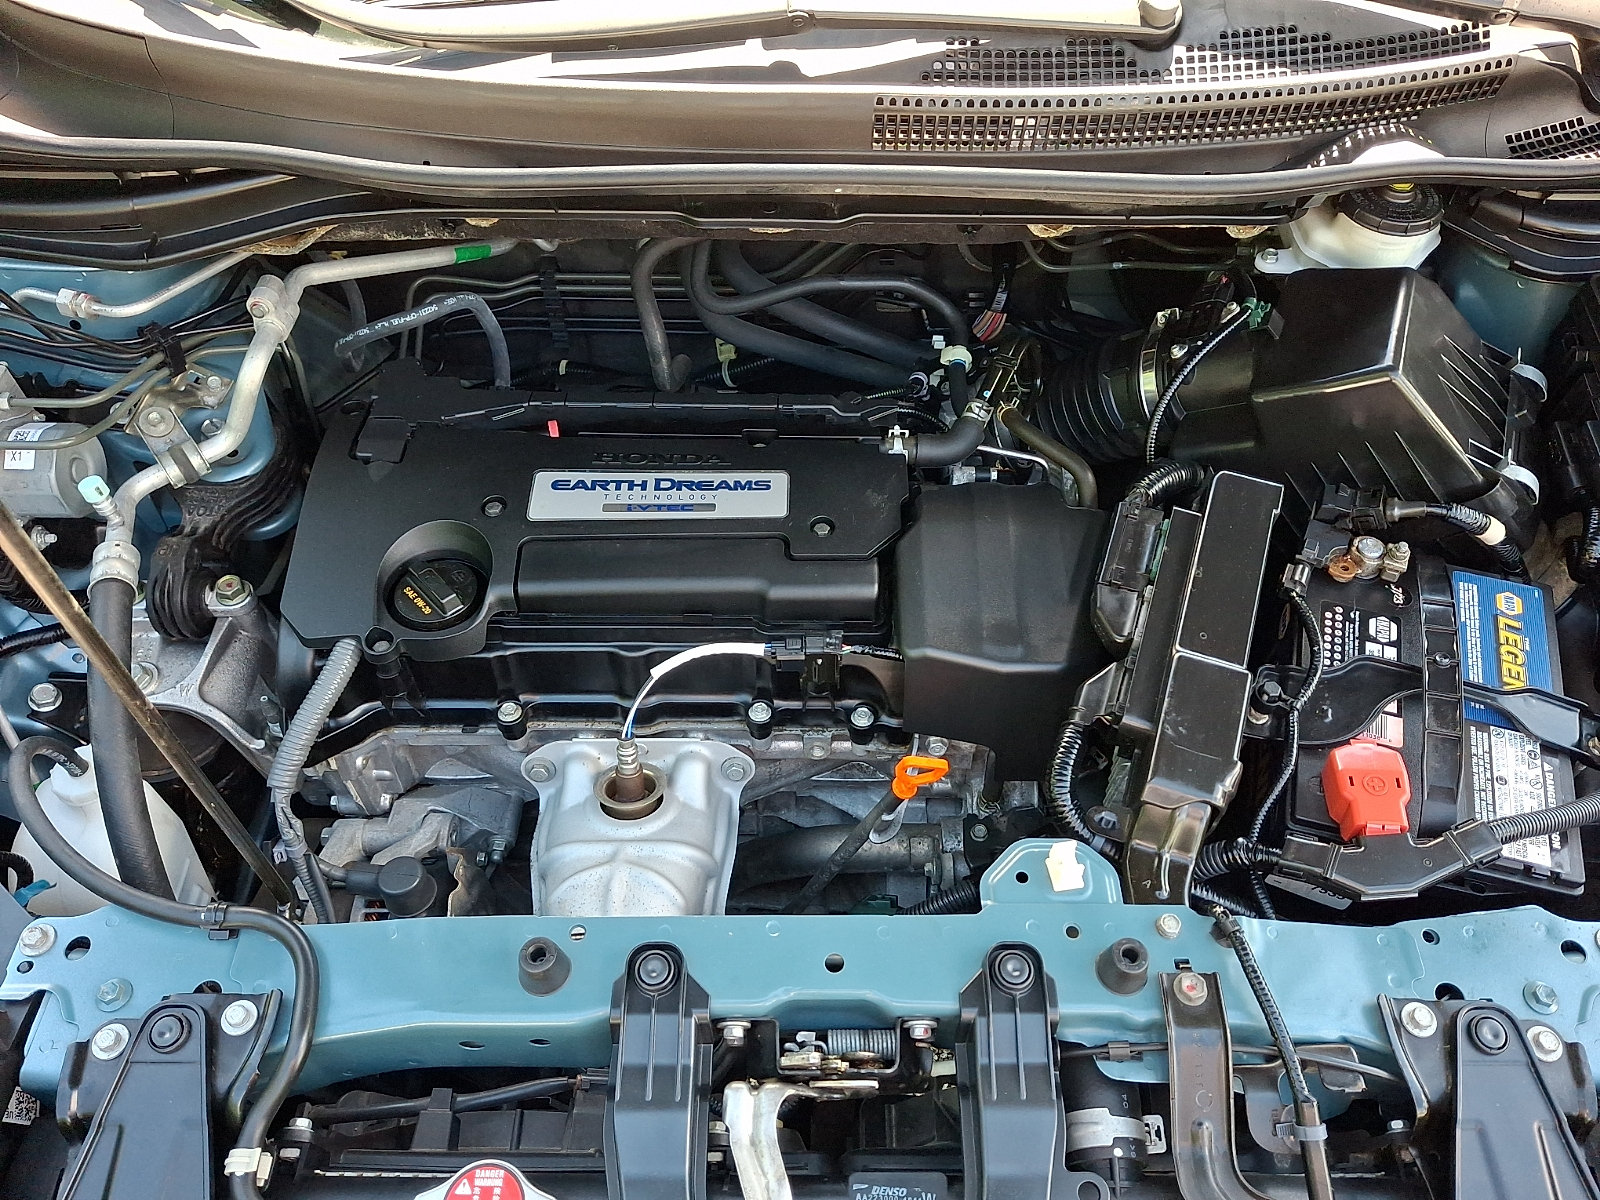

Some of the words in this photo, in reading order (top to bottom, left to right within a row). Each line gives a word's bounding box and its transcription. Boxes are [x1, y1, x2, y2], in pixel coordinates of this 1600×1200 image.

[592, 451, 732, 465] HONDA
[551, 479, 648, 491] EARTH
[653, 478, 772, 491] DREAMS
[604, 493, 718, 501] TECHNOLOGY
[626, 504, 694, 512] i-VTEC
[403, 586, 416, 600] SAE
[413, 597, 432, 615] 0W-20
[1503, 594, 1516, 613] NAPA
[1376, 617, 1391, 643] NAPA
[1497, 616, 1527, 690] LEGEN
[475, 1169, 505, 1178] DANGER
[871, 1185, 908, 1197] DENSO
